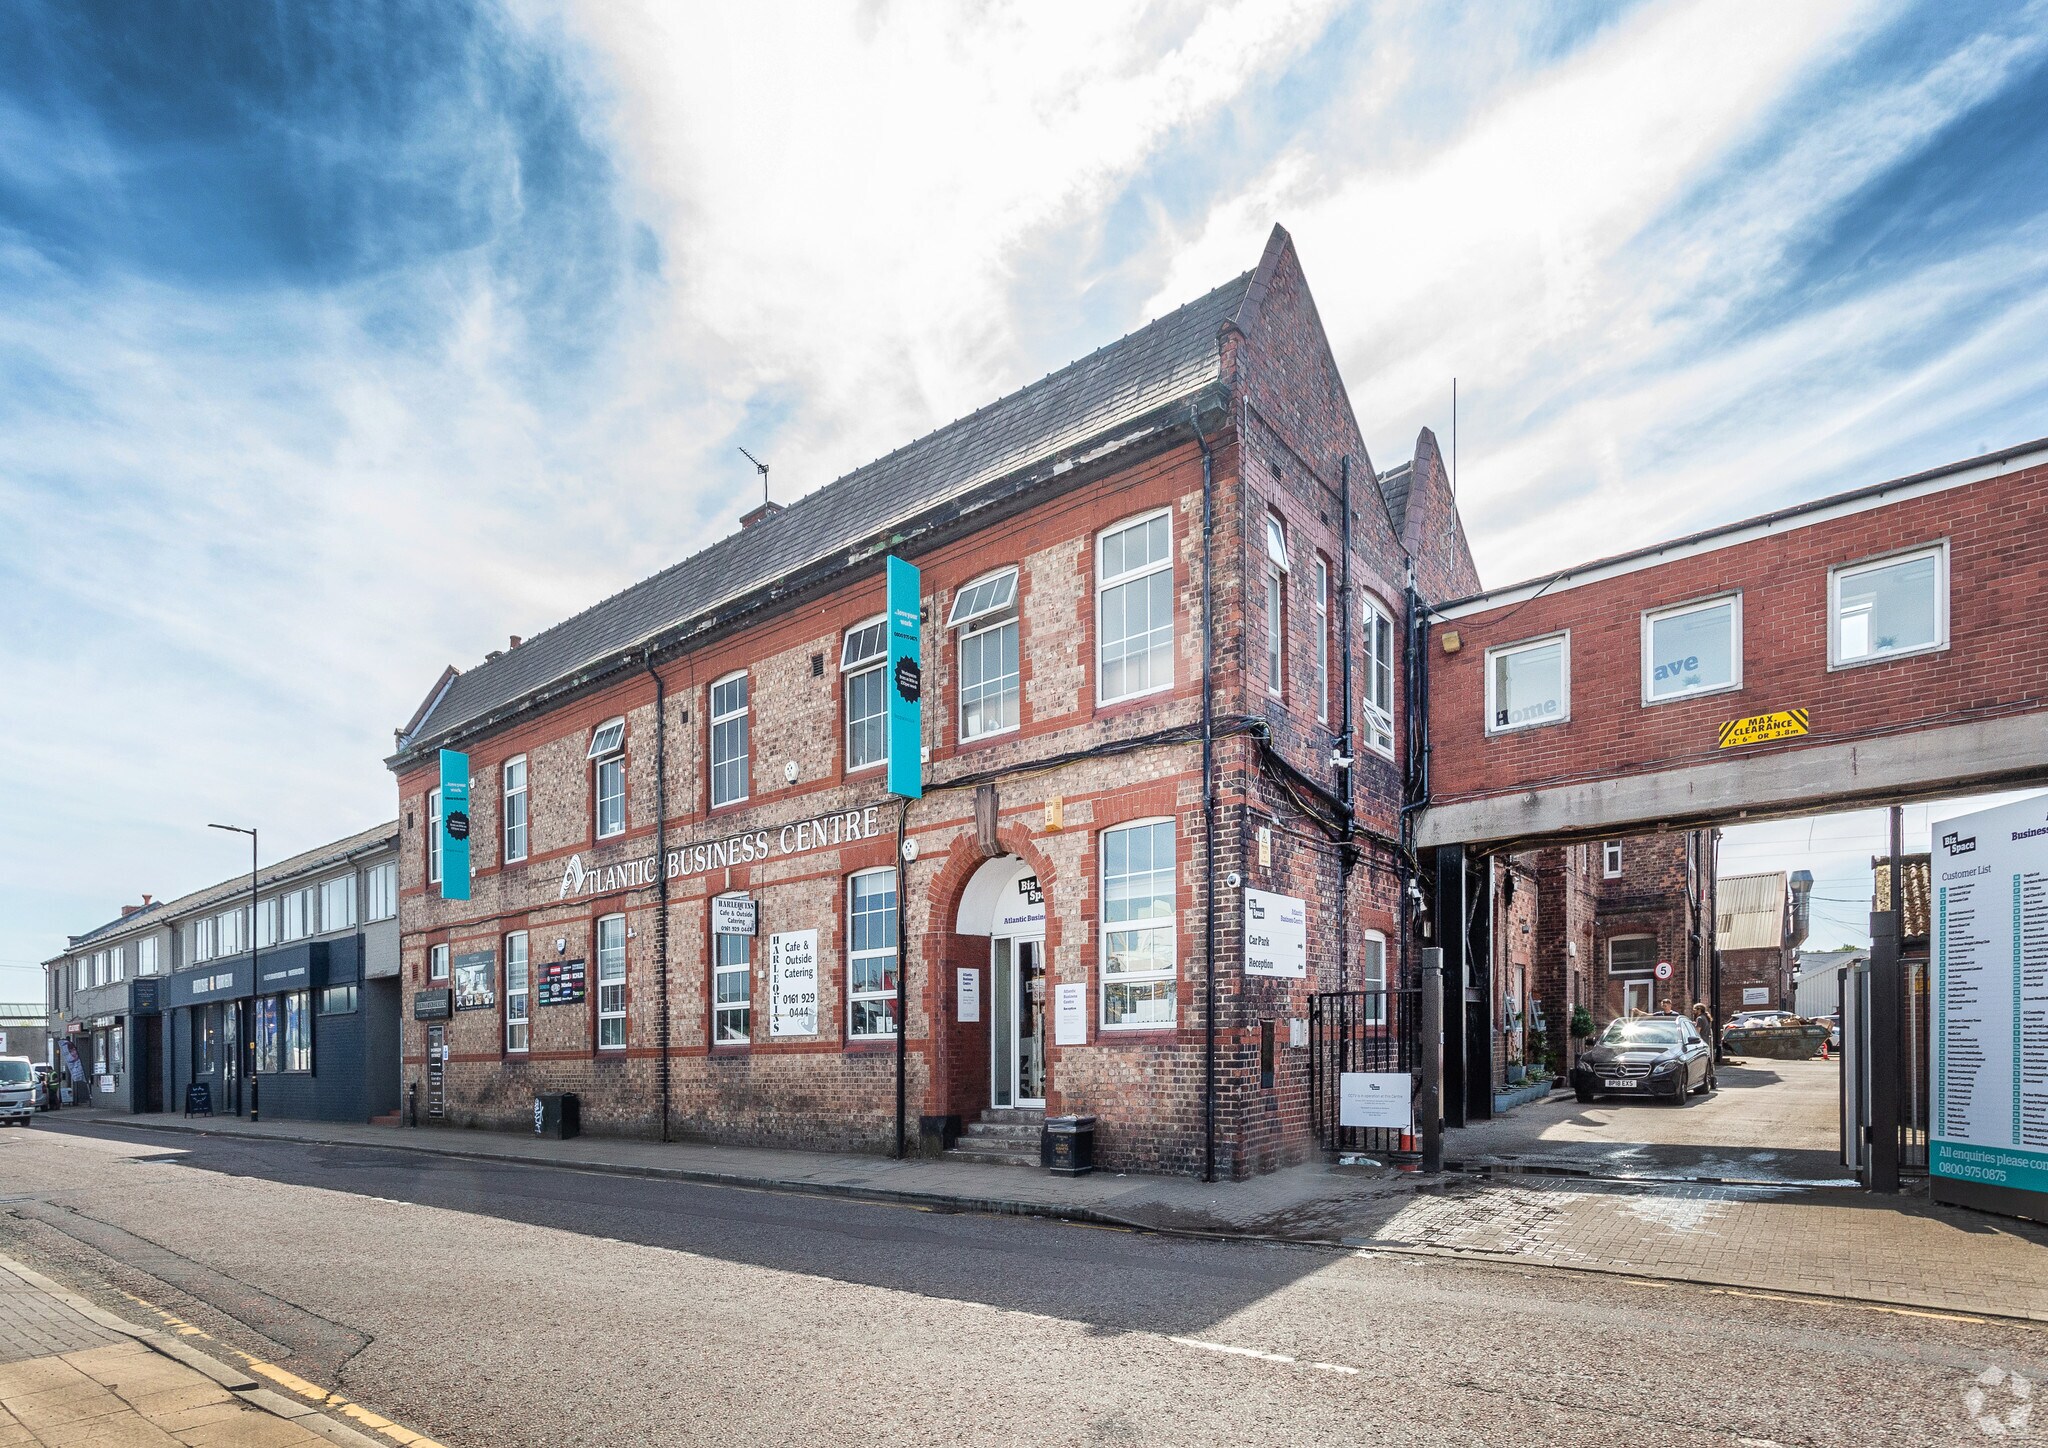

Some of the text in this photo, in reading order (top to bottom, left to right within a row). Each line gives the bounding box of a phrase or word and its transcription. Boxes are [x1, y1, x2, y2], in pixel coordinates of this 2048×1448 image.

[1654, 655, 1699, 681] ave
[1496, 699, 1557, 727] Home
[1734, 720, 1792, 736] CLEARANCE
[1944, 836, 1957, 846] Biz
[1952, 841, 1974, 853] Space
[560, 806, 879, 899] ATLANTIC BUSINESS CENTRE
[1942, 864, 1992, 882] Customer List
[1020, 880, 1036, 891] Biz
[718, 900, 754, 910] HARLEQUINS
[728, 917, 746, 926] Catering
[1004, 916, 1026, 924] Atlantic
[785, 940, 809, 952] Cafe &
[1249, 934, 1270, 946] Car Park
[786, 954, 812, 965] Outside
[1249, 957, 1274, 970] Reception
[784, 968, 814, 979] Catering
[1660, 966, 1666, 976] 5
[783, 992, 815, 1004] 0161 929
[789, 1006, 809, 1018] 0444
[1939, 1146, 1952, 1158] All
[1952, 1150, 1995, 1164] enquiries
[1996, 1154, 2028, 1166] please
[1938, 1162, 2006, 1182] 0800 975 0875
